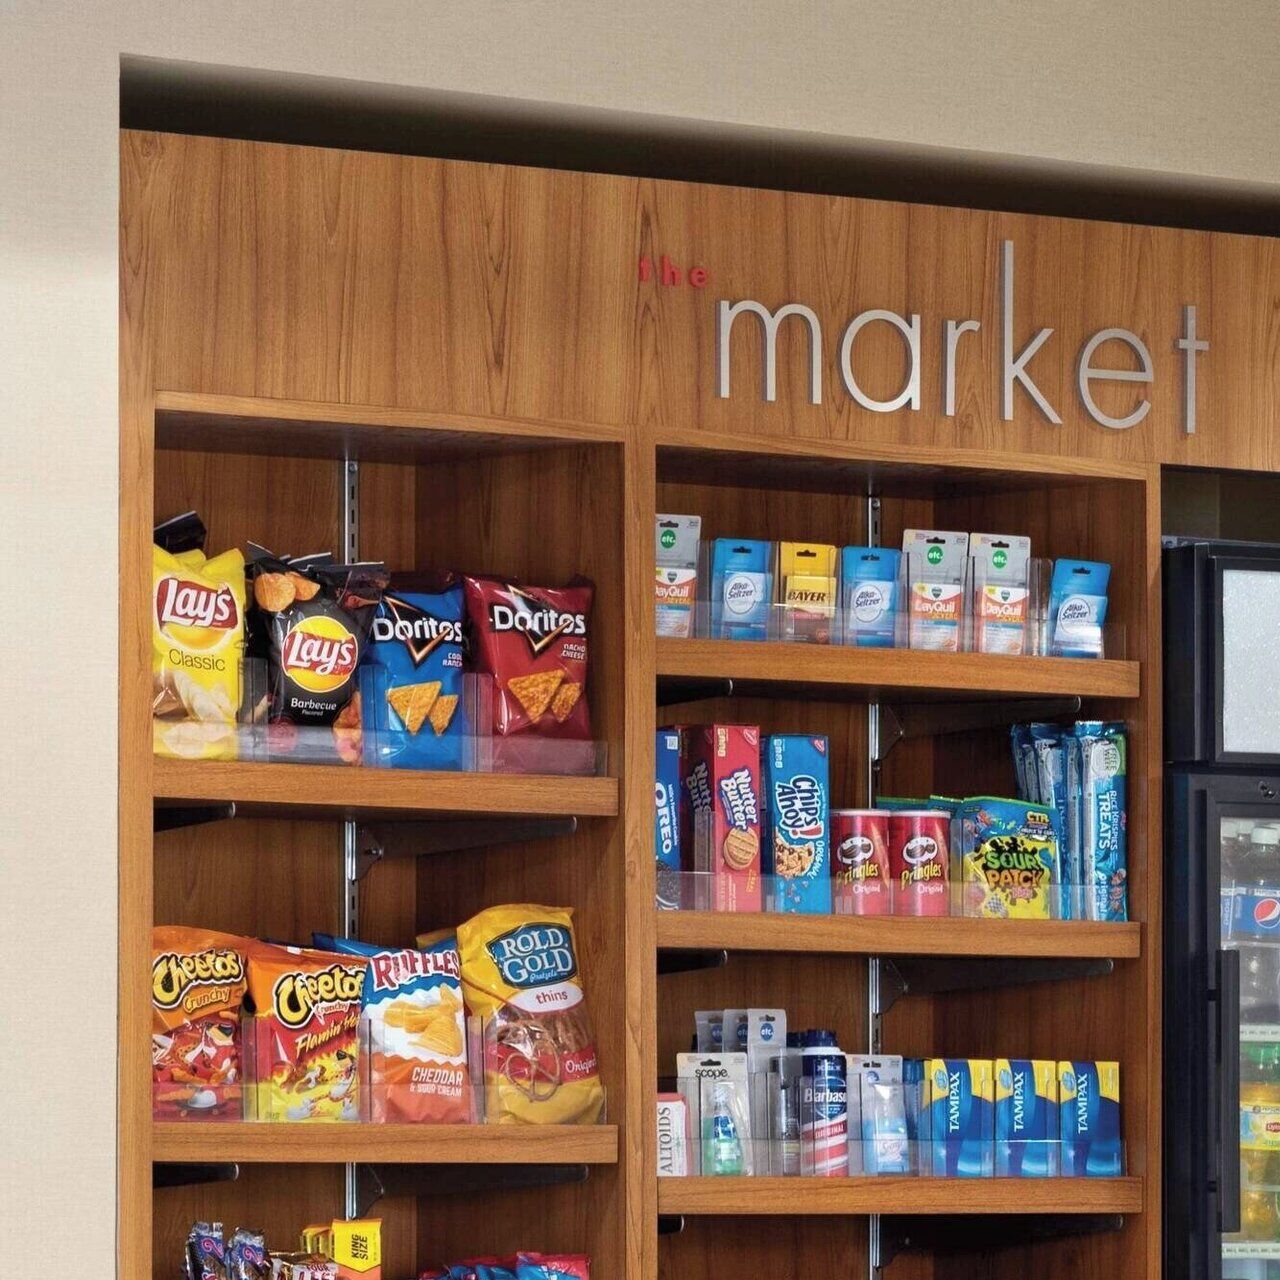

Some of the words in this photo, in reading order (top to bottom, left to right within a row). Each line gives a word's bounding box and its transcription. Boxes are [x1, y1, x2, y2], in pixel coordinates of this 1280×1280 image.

[638, 256, 710, 287] the
[717, 240, 1209, 434] market
[162, 579, 231, 627] Lay's
[788, 591, 826, 601] BAYER
[986, 603, 1021, 615] DayQuil
[373, 618, 462, 641] Doritos
[494, 605, 585, 634] Doritos
[169, 649, 225, 671] Classic
[287, 633, 354, 674] Lay's
[563, 651, 585, 660] CHEESE
[291, 698, 337, 710] Barbecue
[721, 777, 746, 829] Butter
[734, 769, 757, 823] Nutter
[792, 777, 820, 826] Chips
[655, 782, 672, 854] OREO
[1099, 792, 1110, 850] TREATS
[809, 840, 824, 879] ORIGINAL
[901, 860, 941, 890] Pringles
[986, 852, 1039, 869] SOUR
[836, 862, 878, 889] Pringles
[500, 929, 564, 958] ROLD
[153, 952, 242, 1006] Cheetos
[372, 951, 460, 988] RUFFLES
[503, 949, 573, 982] GOLD
[184, 988, 230, 1012] Crunchy
[536, 990, 568, 1004] thins
[295, 1020, 343, 1058] Flamin'
[412, 1067, 463, 1084] CHEDDAR
[695, 1068, 728, 1080] scope
[438, 1086, 462, 1097] CREAM
[950, 1071, 959, 1132] TAMPAX
[1014, 1071, 1024, 1132] TAMPAX
[1078, 1073, 1088, 1133] TAMPAX
[658, 1106, 673, 1173] ALTOIDS
[360, 1236, 369, 1260] SIZE
